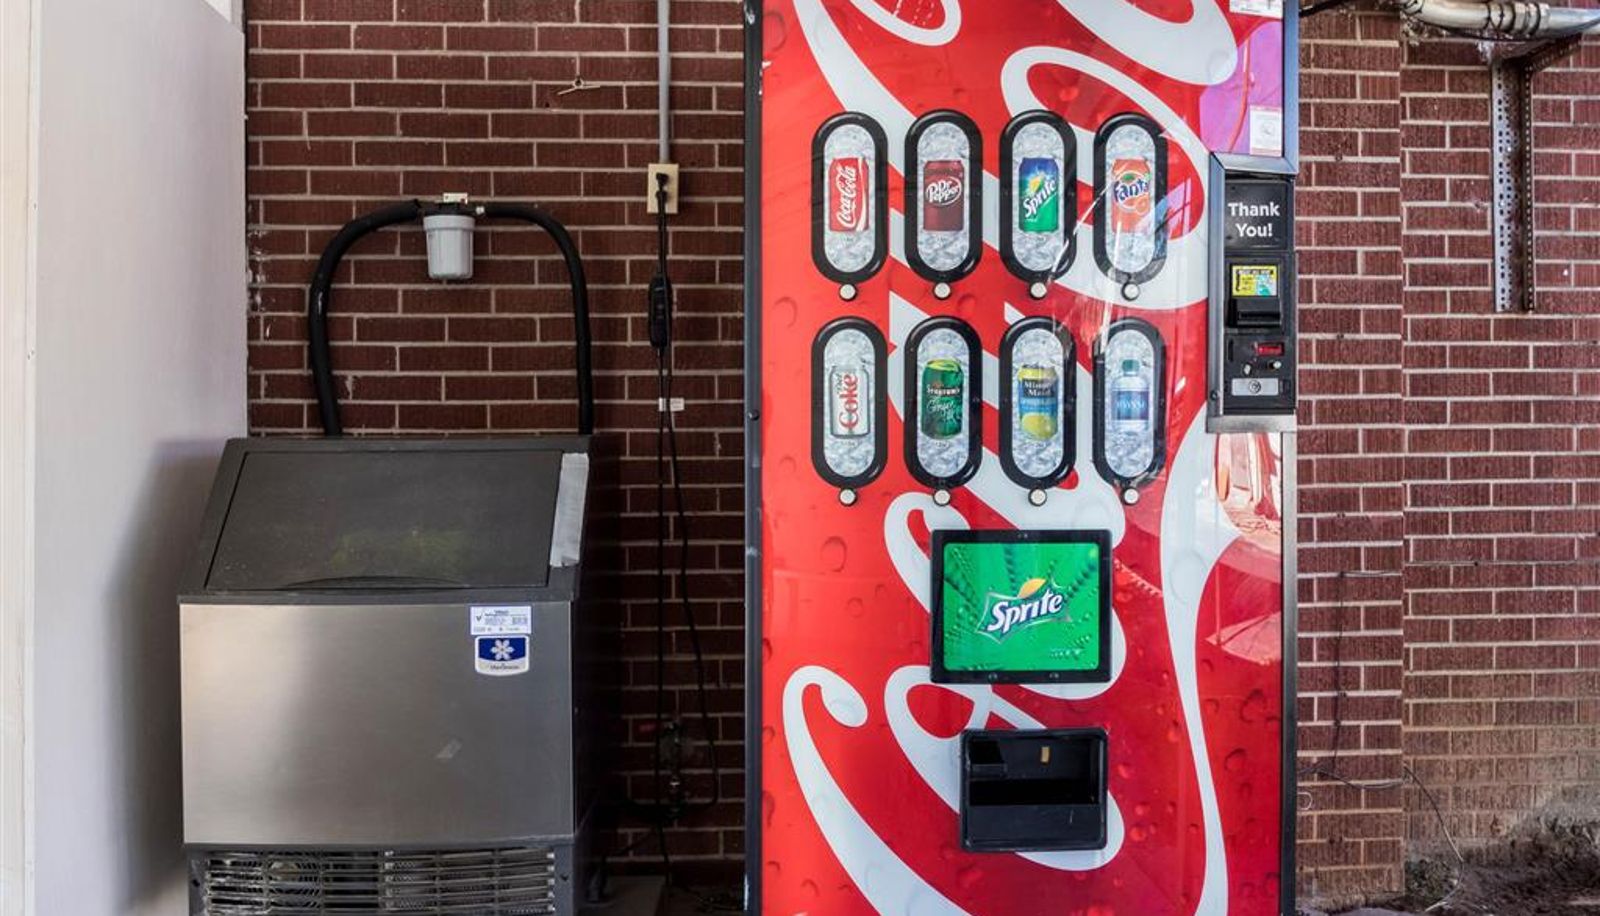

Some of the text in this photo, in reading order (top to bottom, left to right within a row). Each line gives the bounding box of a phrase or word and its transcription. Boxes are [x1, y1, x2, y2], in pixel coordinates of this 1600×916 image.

[1023, 179, 1057, 218] Sprite
[1228, 202, 1280, 218] Thank
[1235, 223, 1273, 238] You!
[839, 374, 859, 428] Coke
[986, 588, 1063, 634] Sprite
